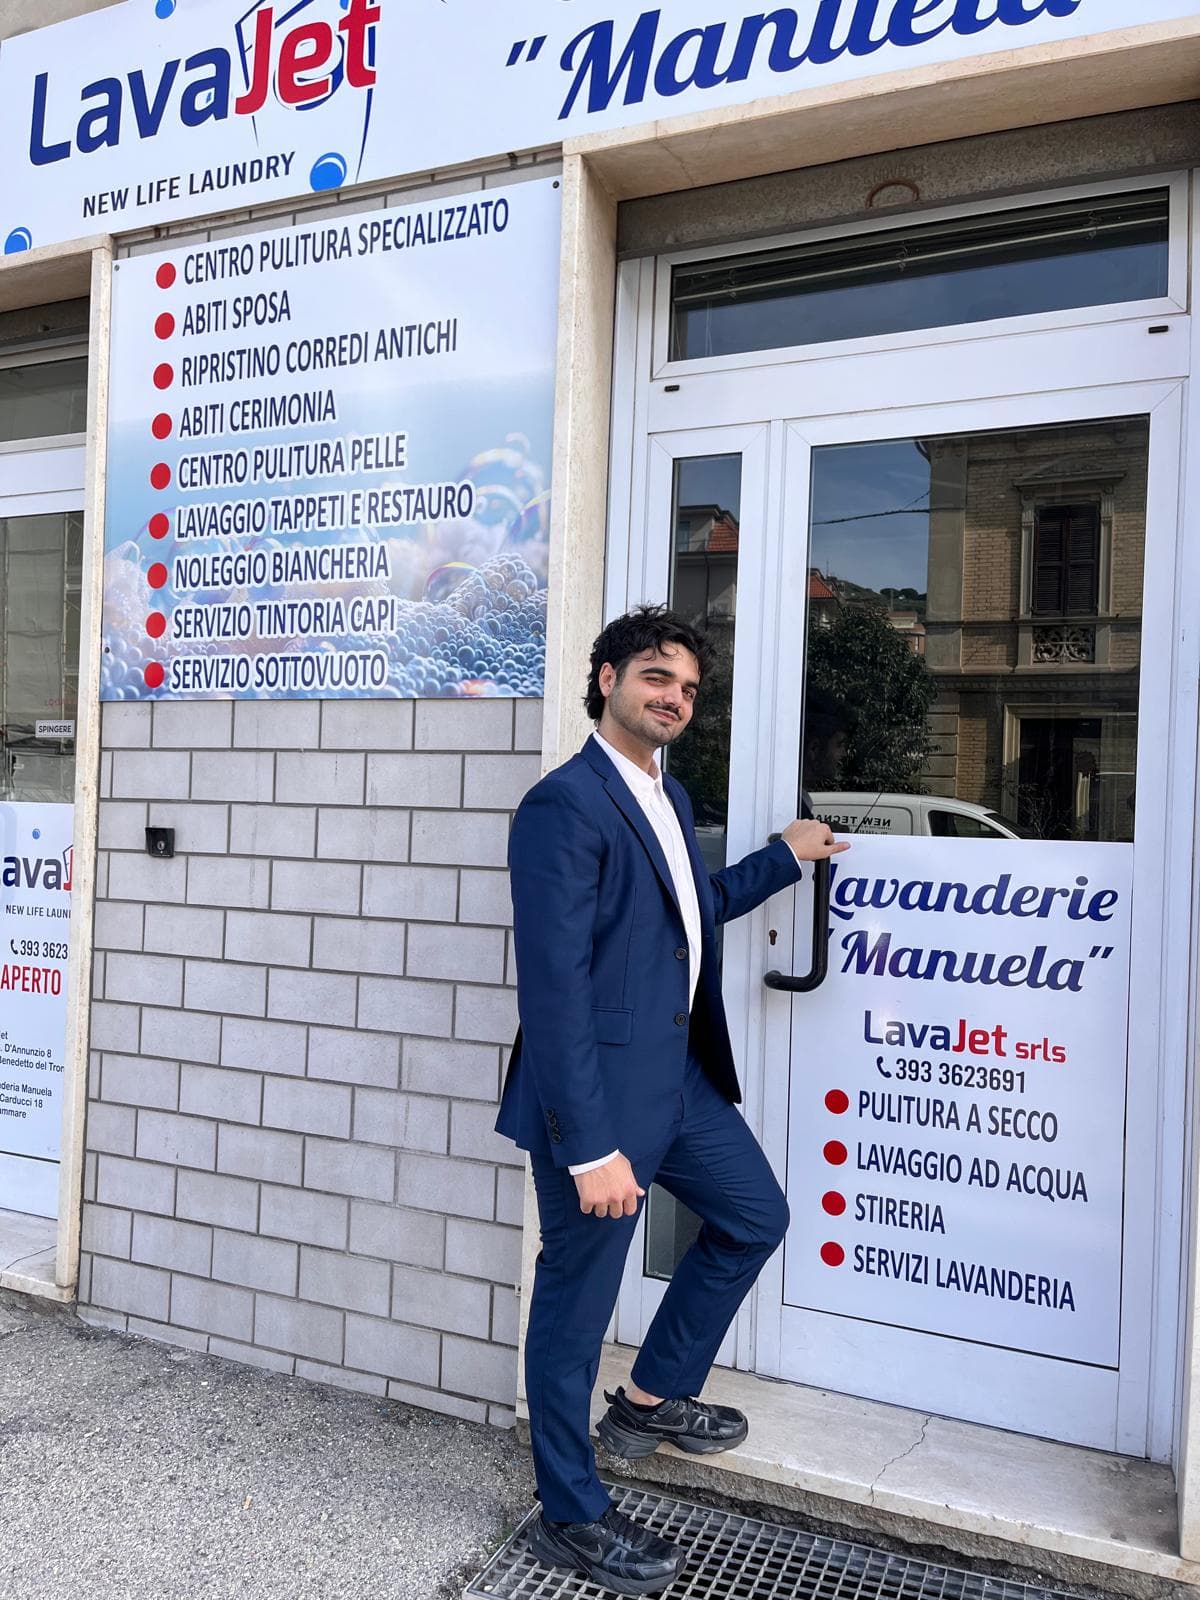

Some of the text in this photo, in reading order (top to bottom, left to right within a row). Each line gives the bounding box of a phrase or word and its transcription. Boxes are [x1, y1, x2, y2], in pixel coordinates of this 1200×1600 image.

[29, 0, 381, 167] LavaJet
[83, 151, 296, 218] NEW LIFE LAUNDRY
[184, 198, 509, 285] CENTRO PULITURA SPECIALIZZATO
[182, 290, 291, 336] ABITI SPOSA
[181, 318, 458, 387] RIPRISTINO CORREDI ANTICHI
[179, 389, 336, 438] ABITI CERIMONIA
[179, 434, 406, 488] CENTRO PULITURA PELLE
[177, 483, 473, 539] LAVAGGIO TAPPETI E RESTAURO
[175, 545, 389, 589] NOLEGGIO BIANCHERIA
[173, 599, 395, 639] SERVIZIO TINTORIA CAPI
[172, 653, 385, 690] SERVIZIO SOTTOVUOTO
[38, 725, 72, 733] SPINGERE
[6, 905, 24, 915] NEW
[27, 906, 43, 917] LIFE
[20, 940, 68, 959] 393 3623
[828, 928, 1114, 992] Manuela"
[1, 964, 61, 995] APERTO
[5, 1044, 52, 1058] D'Annunzio 8
[864, 1010, 1066, 1063] LavaJet srls
[36, 1060, 46, 1071] del
[896, 1058, 1025, 1093] 393 3623691
[0, 1094, 43, 1108] Carducci 18
[22, 1084, 52, 1097] Manuela
[859, 1090, 1058, 1142] PULITURA A SECCO
[857, 1142, 1088, 1203] LAVAGGIO AD ACQUA
[855, 1193, 945, 1234] STIRERIA
[853, 1244, 1075, 1312] SERVIZI LAVANDERIA
